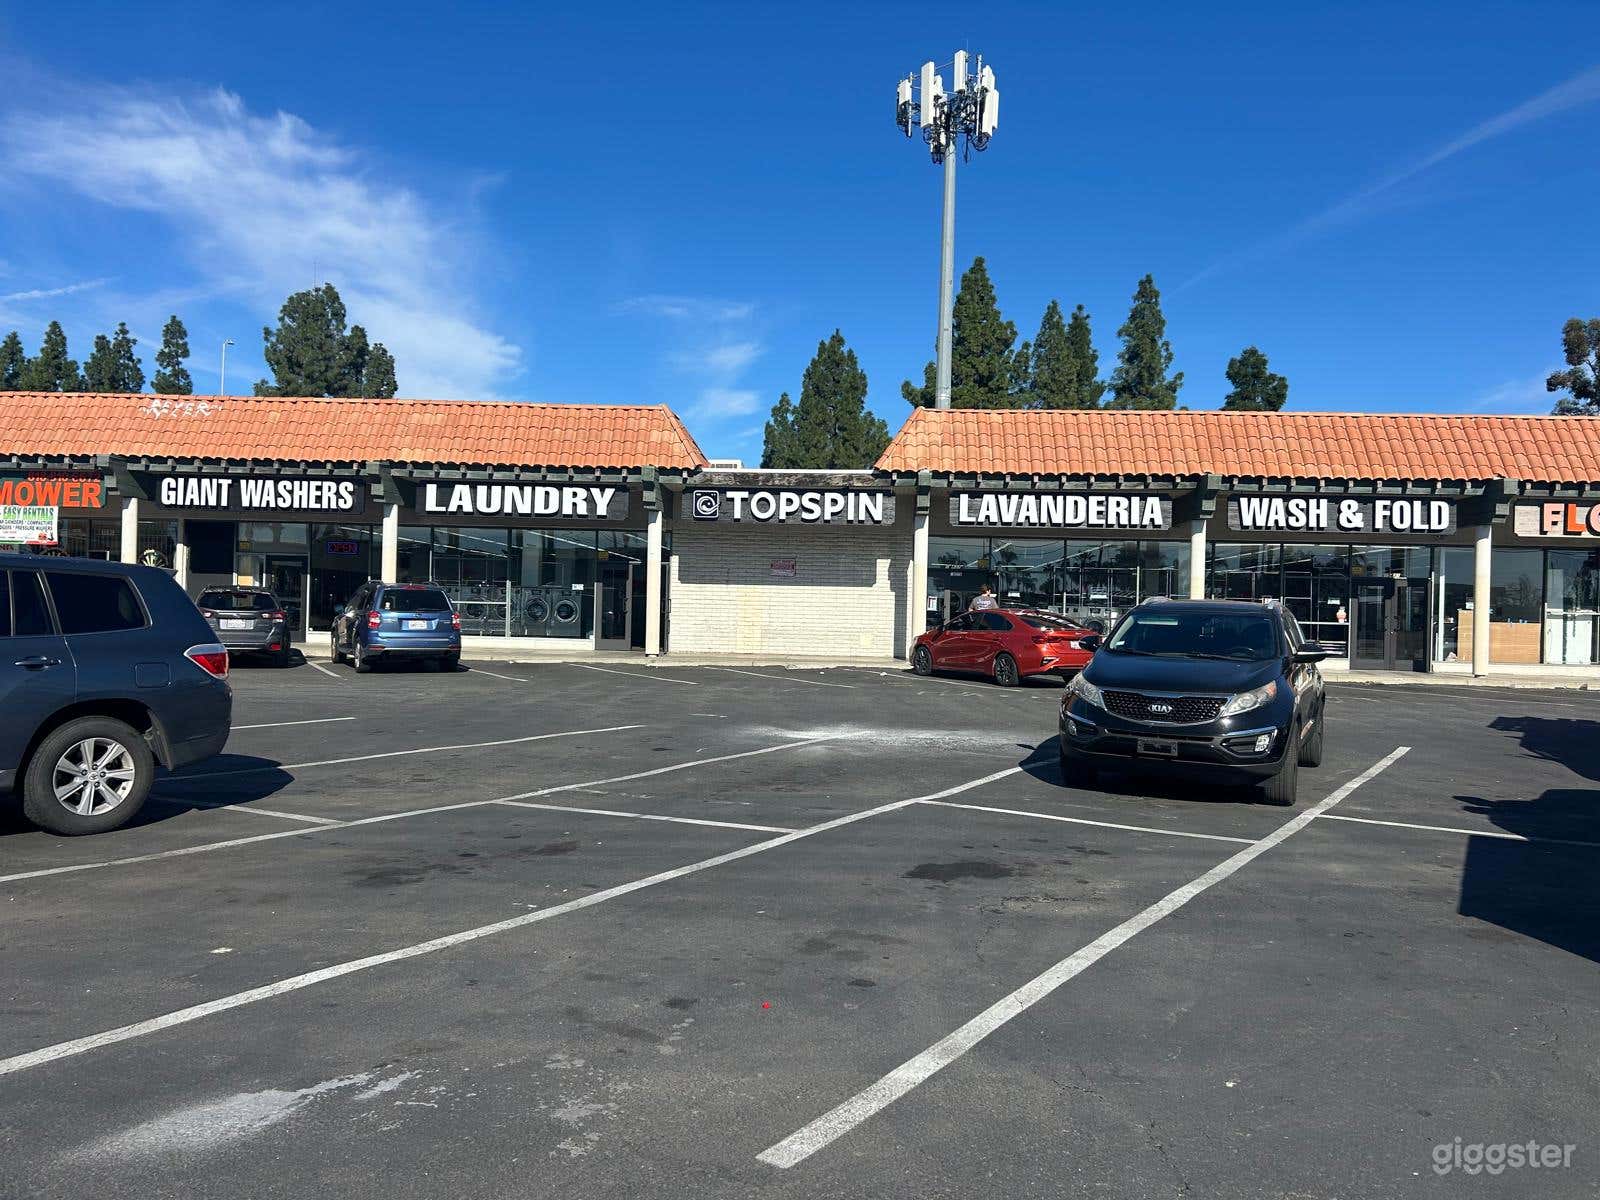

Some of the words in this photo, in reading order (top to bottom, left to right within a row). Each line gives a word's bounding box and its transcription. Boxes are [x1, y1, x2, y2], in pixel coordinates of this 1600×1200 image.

[0, 481, 101, 508] MOWER
[161, 477, 232, 506] GIANT
[240, 479, 354, 509] WASHERS
[425, 483, 616, 516] LAUNDRY
[727, 491, 884, 521] TOPSPIN
[3, 506, 21, 519] EASY
[23, 507, 54, 520] RENTALS
[959, 494, 1164, 526] LAVANDERIA
[1240, 497, 1328, 528] WASH
[1340, 499, 1365, 529] &
[1375, 499, 1450, 530] FOLD
[1151, 704, 1168, 713] KIA
